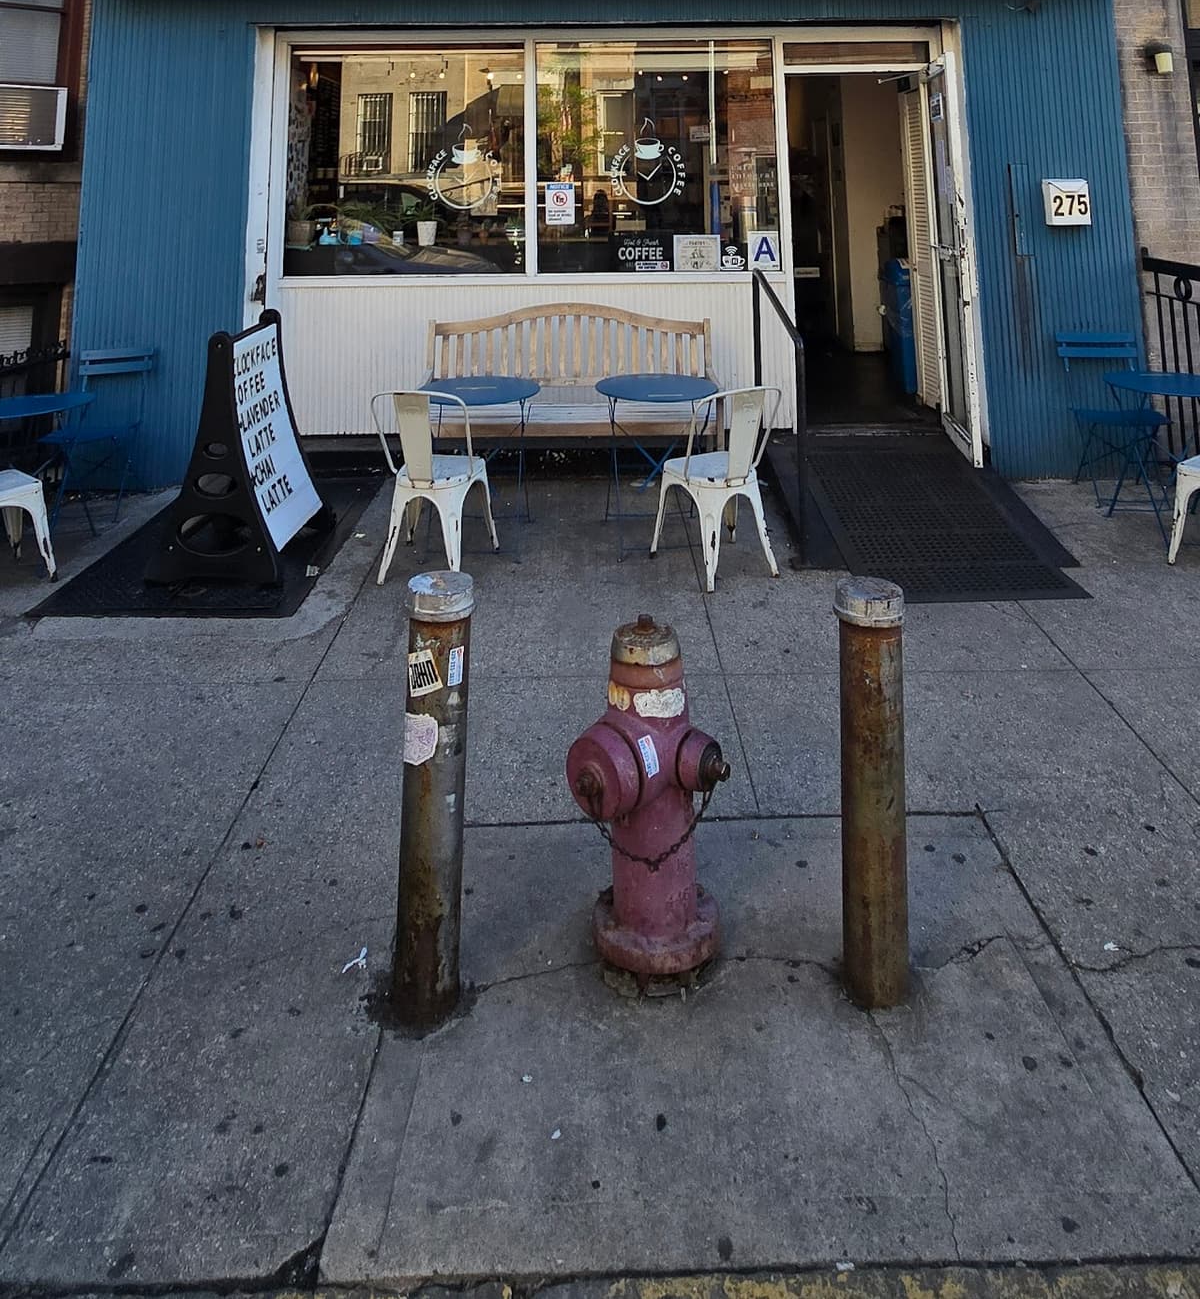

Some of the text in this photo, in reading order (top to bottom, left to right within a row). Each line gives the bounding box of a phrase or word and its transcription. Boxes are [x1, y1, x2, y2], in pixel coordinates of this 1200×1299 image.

[426, 148, 448, 200] CLOCKFACE
[610, 144, 686, 196] CLOCKFACE COFFEE
[1053, 194, 1088, 217] 275
[618, 247, 663, 260] COFFEE
[753, 236, 777, 262] A
[233, 337, 277, 377] LOCKFACE
[248, 422, 275, 458] LATTE
[261, 474, 293, 515] LATTE
